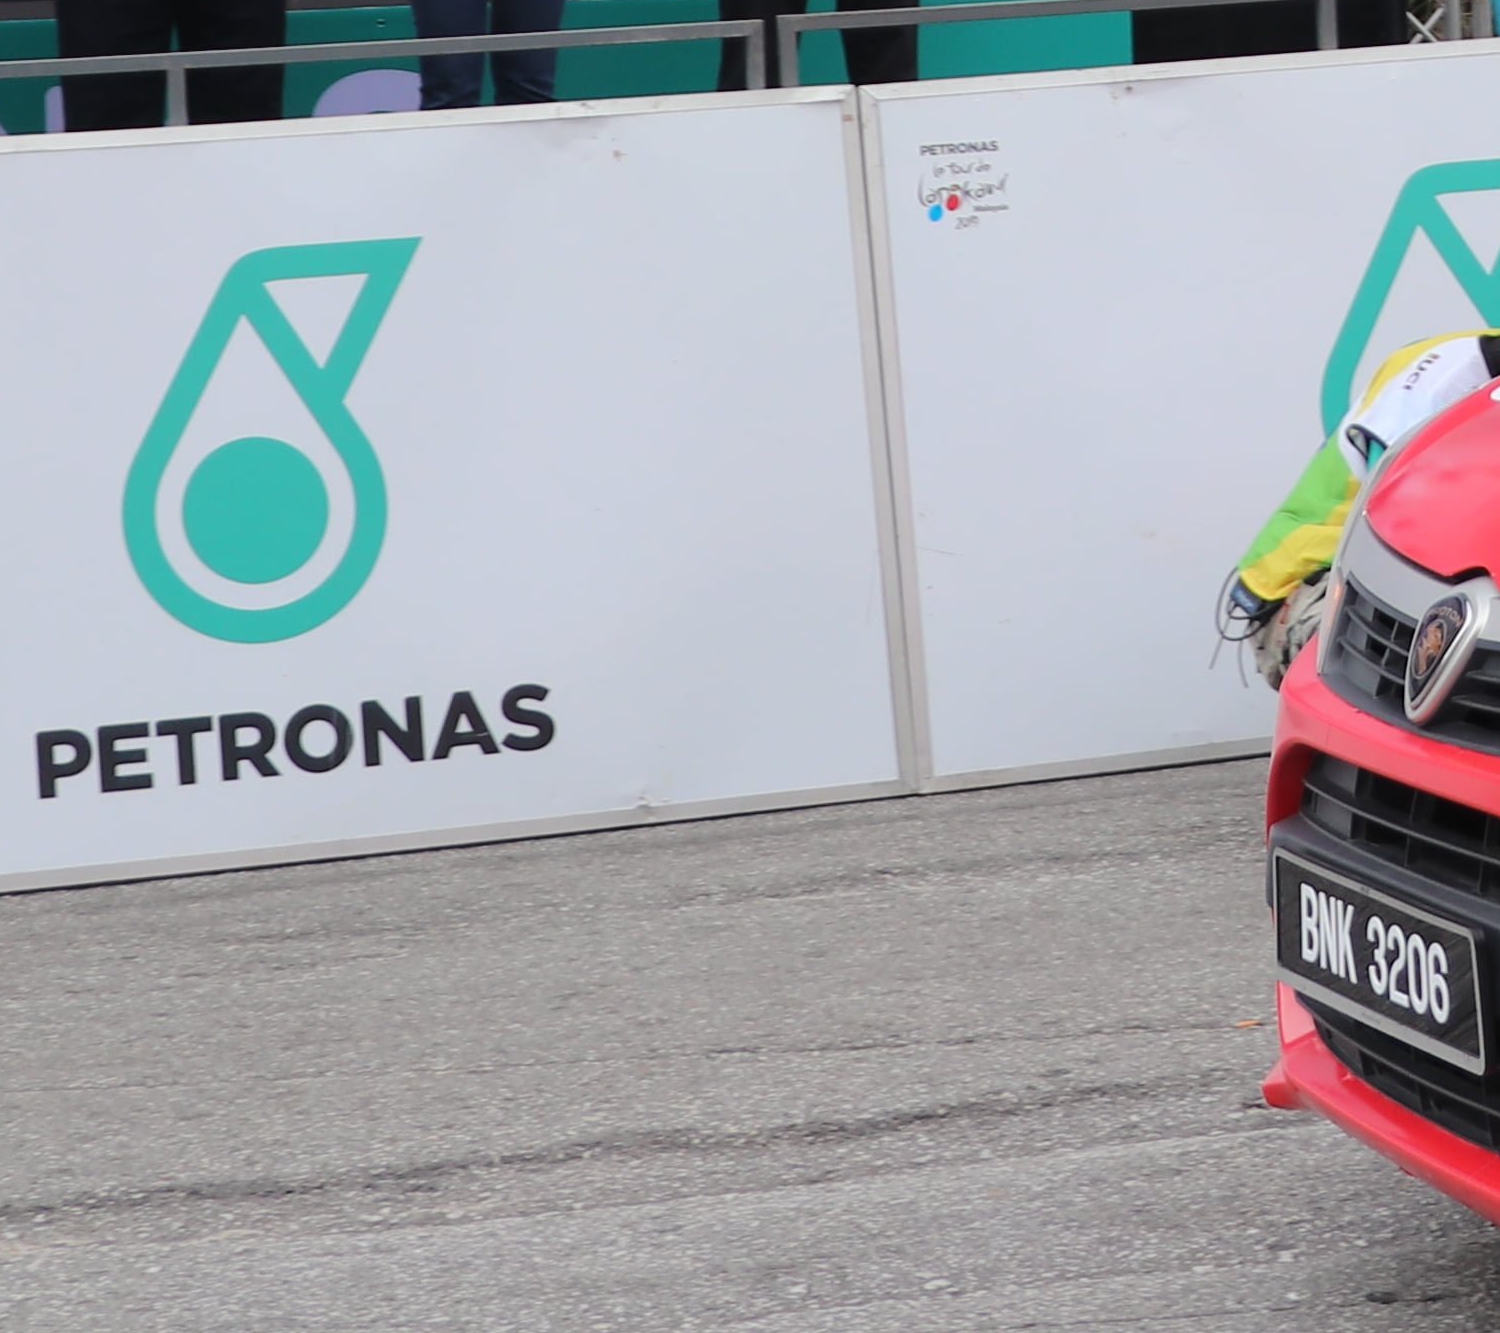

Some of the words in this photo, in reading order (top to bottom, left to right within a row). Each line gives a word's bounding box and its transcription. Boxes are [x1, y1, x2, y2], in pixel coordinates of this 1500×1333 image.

[918, 140, 1000, 156] PETRONAS
[37, 681, 557, 801] PETRONAS
[1300, 882, 1358, 985] BNK
[1366, 915, 1450, 1025] 3206
